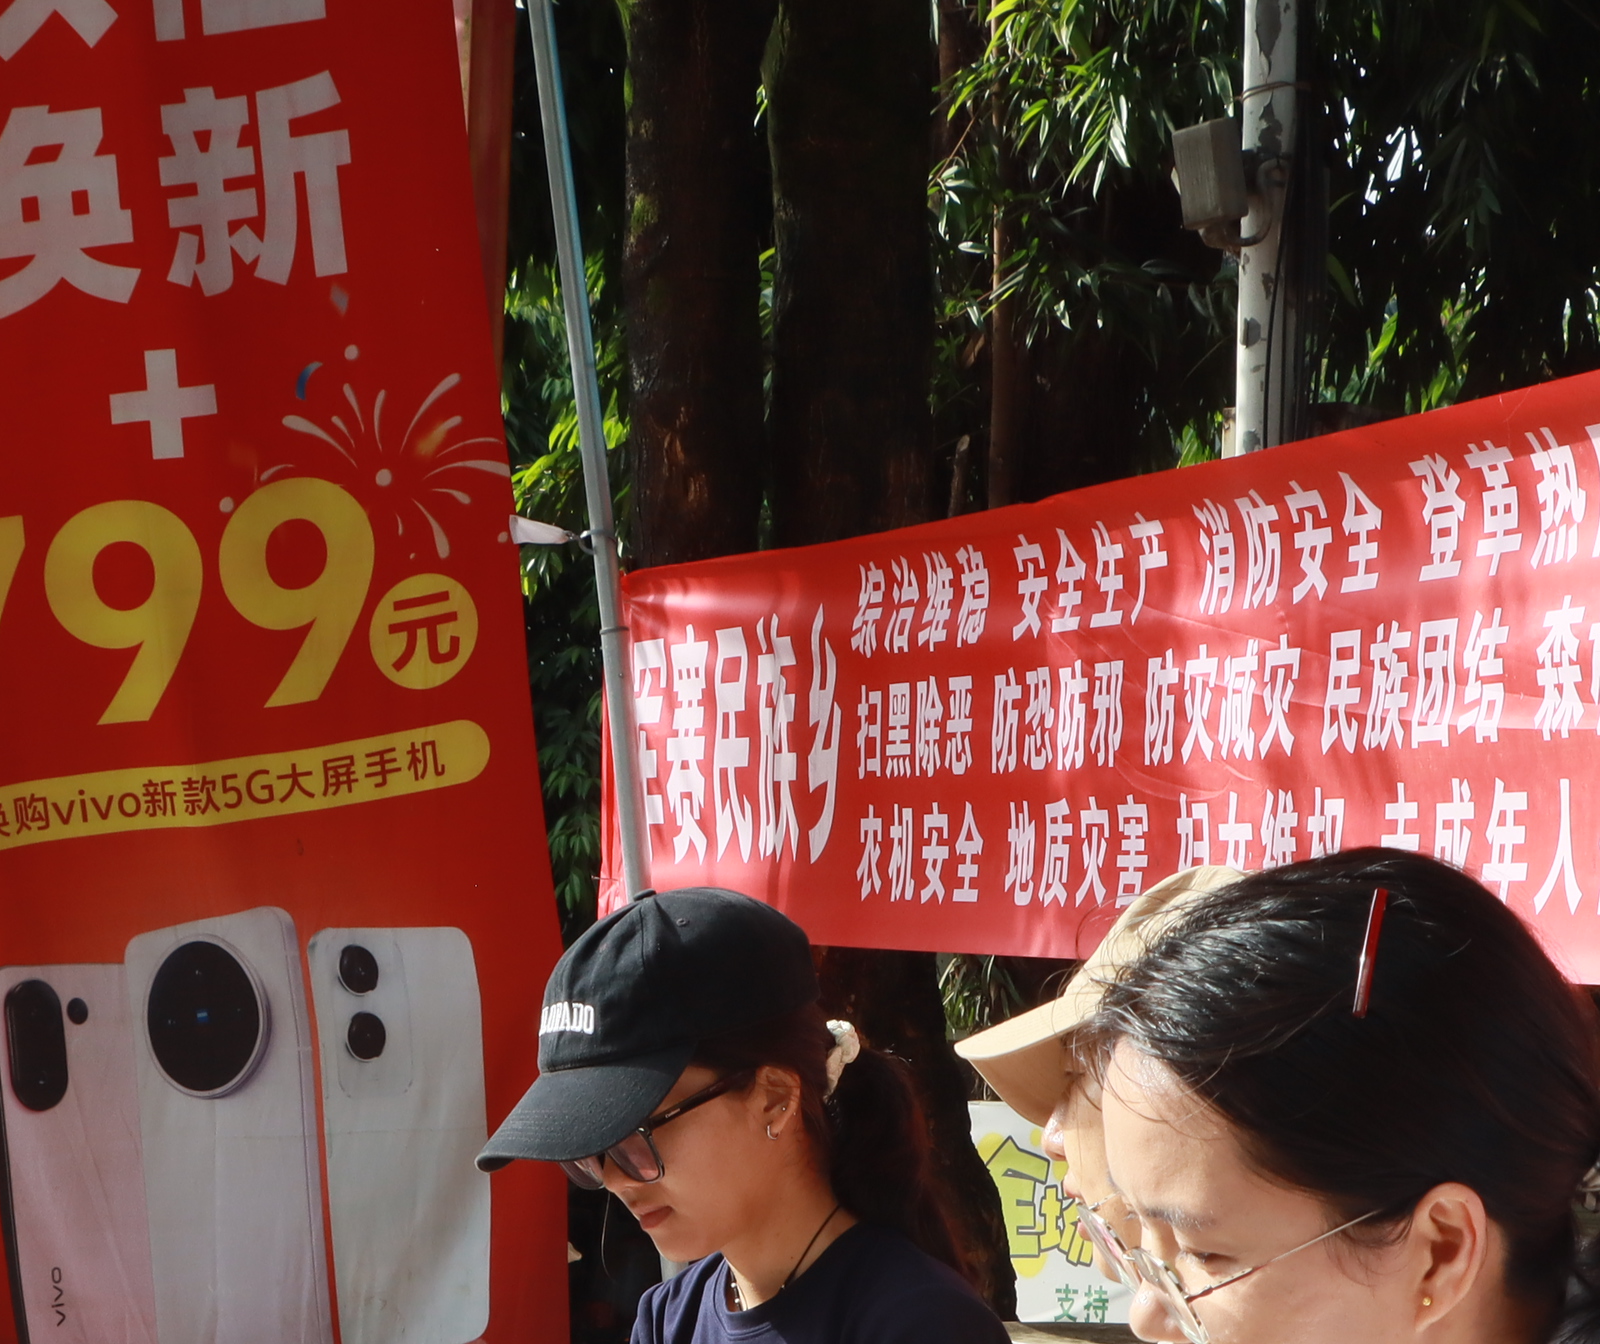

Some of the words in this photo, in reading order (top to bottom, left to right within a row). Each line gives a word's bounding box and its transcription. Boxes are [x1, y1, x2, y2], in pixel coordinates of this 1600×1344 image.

[851, 543, 990, 659] 综治维稳
[1012, 511, 1169, 642] 安全生产
[1192, 471, 1383, 616] 消防安全
[388, 590, 461, 672] 元
[856, 675, 973, 781] 扫黑除恶
[991, 658, 1125, 774] 防恐防邪
[1144, 633, 1304, 767] 防灾减灾
[1320, 605, 1511, 757] 民族团结
[856, 802, 984, 905] 农机安全
[1005, 793, 1150, 910] 地质灾害
[51, 1266, 66, 1327] vivo
